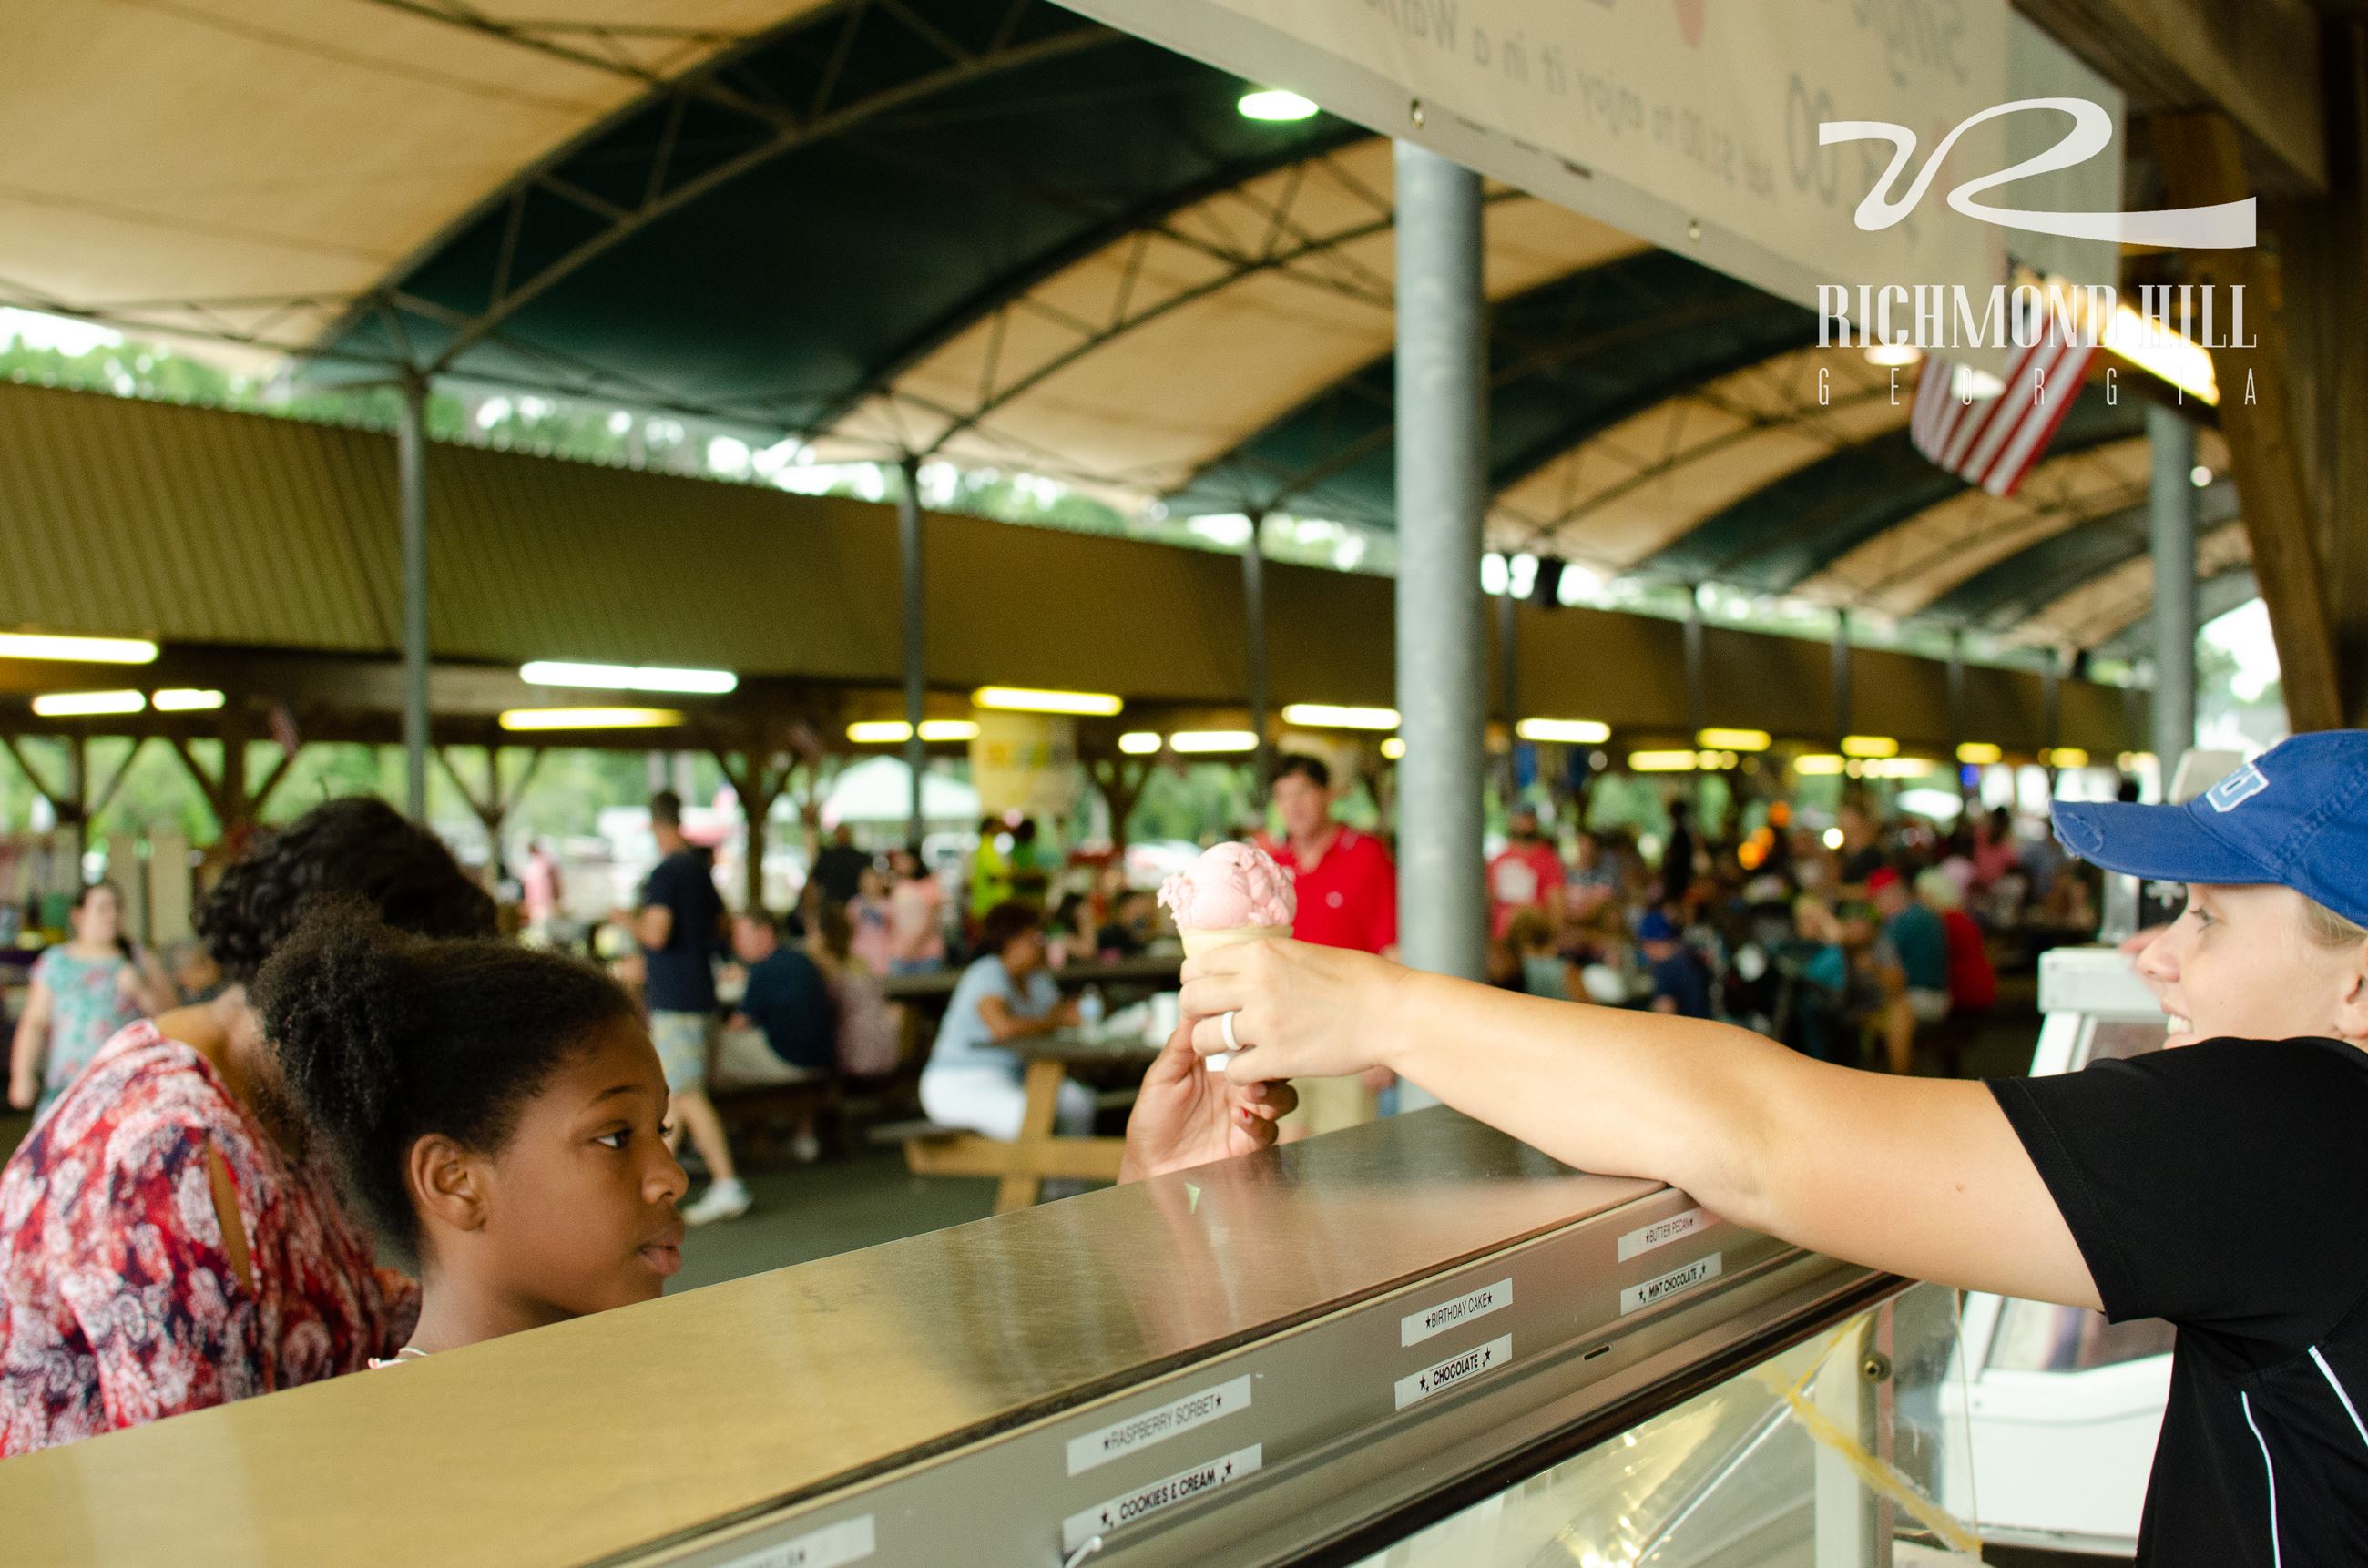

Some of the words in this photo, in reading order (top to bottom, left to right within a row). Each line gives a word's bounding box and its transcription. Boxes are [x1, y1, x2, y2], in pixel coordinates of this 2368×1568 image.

[1649, 1222, 1670, 1243] BUTTER
[1672, 1217, 1690, 1234] PECAN
[1648, 1281, 1663, 1298] MINT
[1665, 1268, 1697, 1291] CHOCOLATE
[1431, 1301, 1466, 1328] BIRTHDAY
[1468, 1293, 1487, 1312] CAKE
[1434, 1354, 1478, 1385] CHOCOLATE
[1110, 1410, 1173, 1448] RASPBERRY
[1176, 1395, 1215, 1424] SORBET
[1120, 1486, 1168, 1519] COOKIES
[1179, 1470, 1215, 1495] CREAM
